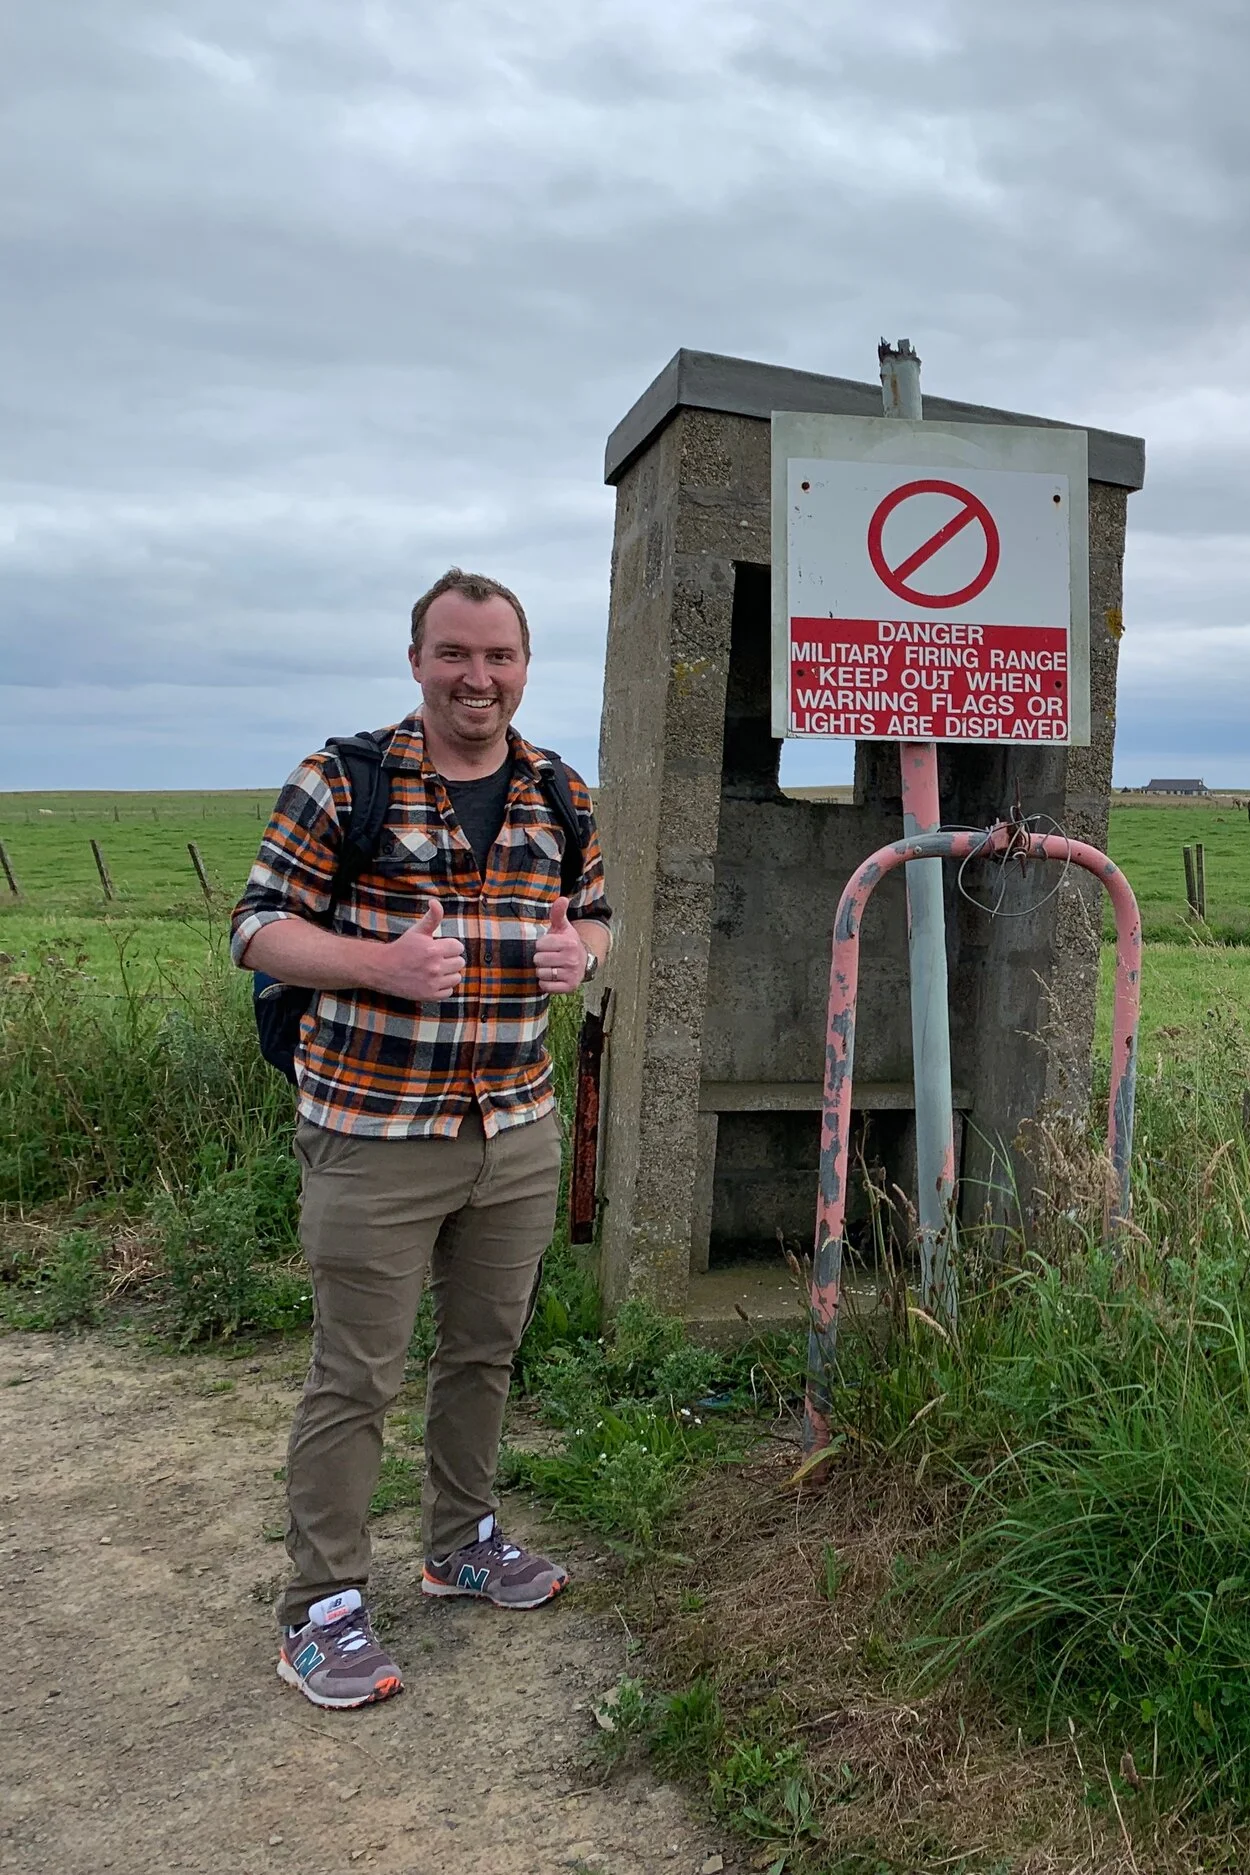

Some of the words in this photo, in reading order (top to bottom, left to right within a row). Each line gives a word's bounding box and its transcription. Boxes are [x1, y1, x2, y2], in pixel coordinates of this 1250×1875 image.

[878, 622, 984, 645] DANGER
[792, 642, 893, 665] MILITARY
[905, 646, 979, 668] FIRING
[990, 649, 1067, 671] RANGE
[820, 666, 888, 687] KEEP
[900, 669, 954, 690] OUT
[966, 671, 1041, 693] WHEN
[796, 689, 918, 712] WARNING
[932, 693, 1015, 715] FLAGS
[1027, 696, 1063, 717] OR
[792, 712, 875, 734] LIGHTS
[887, 715, 933, 736] ARE
[945, 716, 1067, 739] DISPLAYED
[456, 1564, 490, 1592] N
[294, 1641, 325, 1680] N
